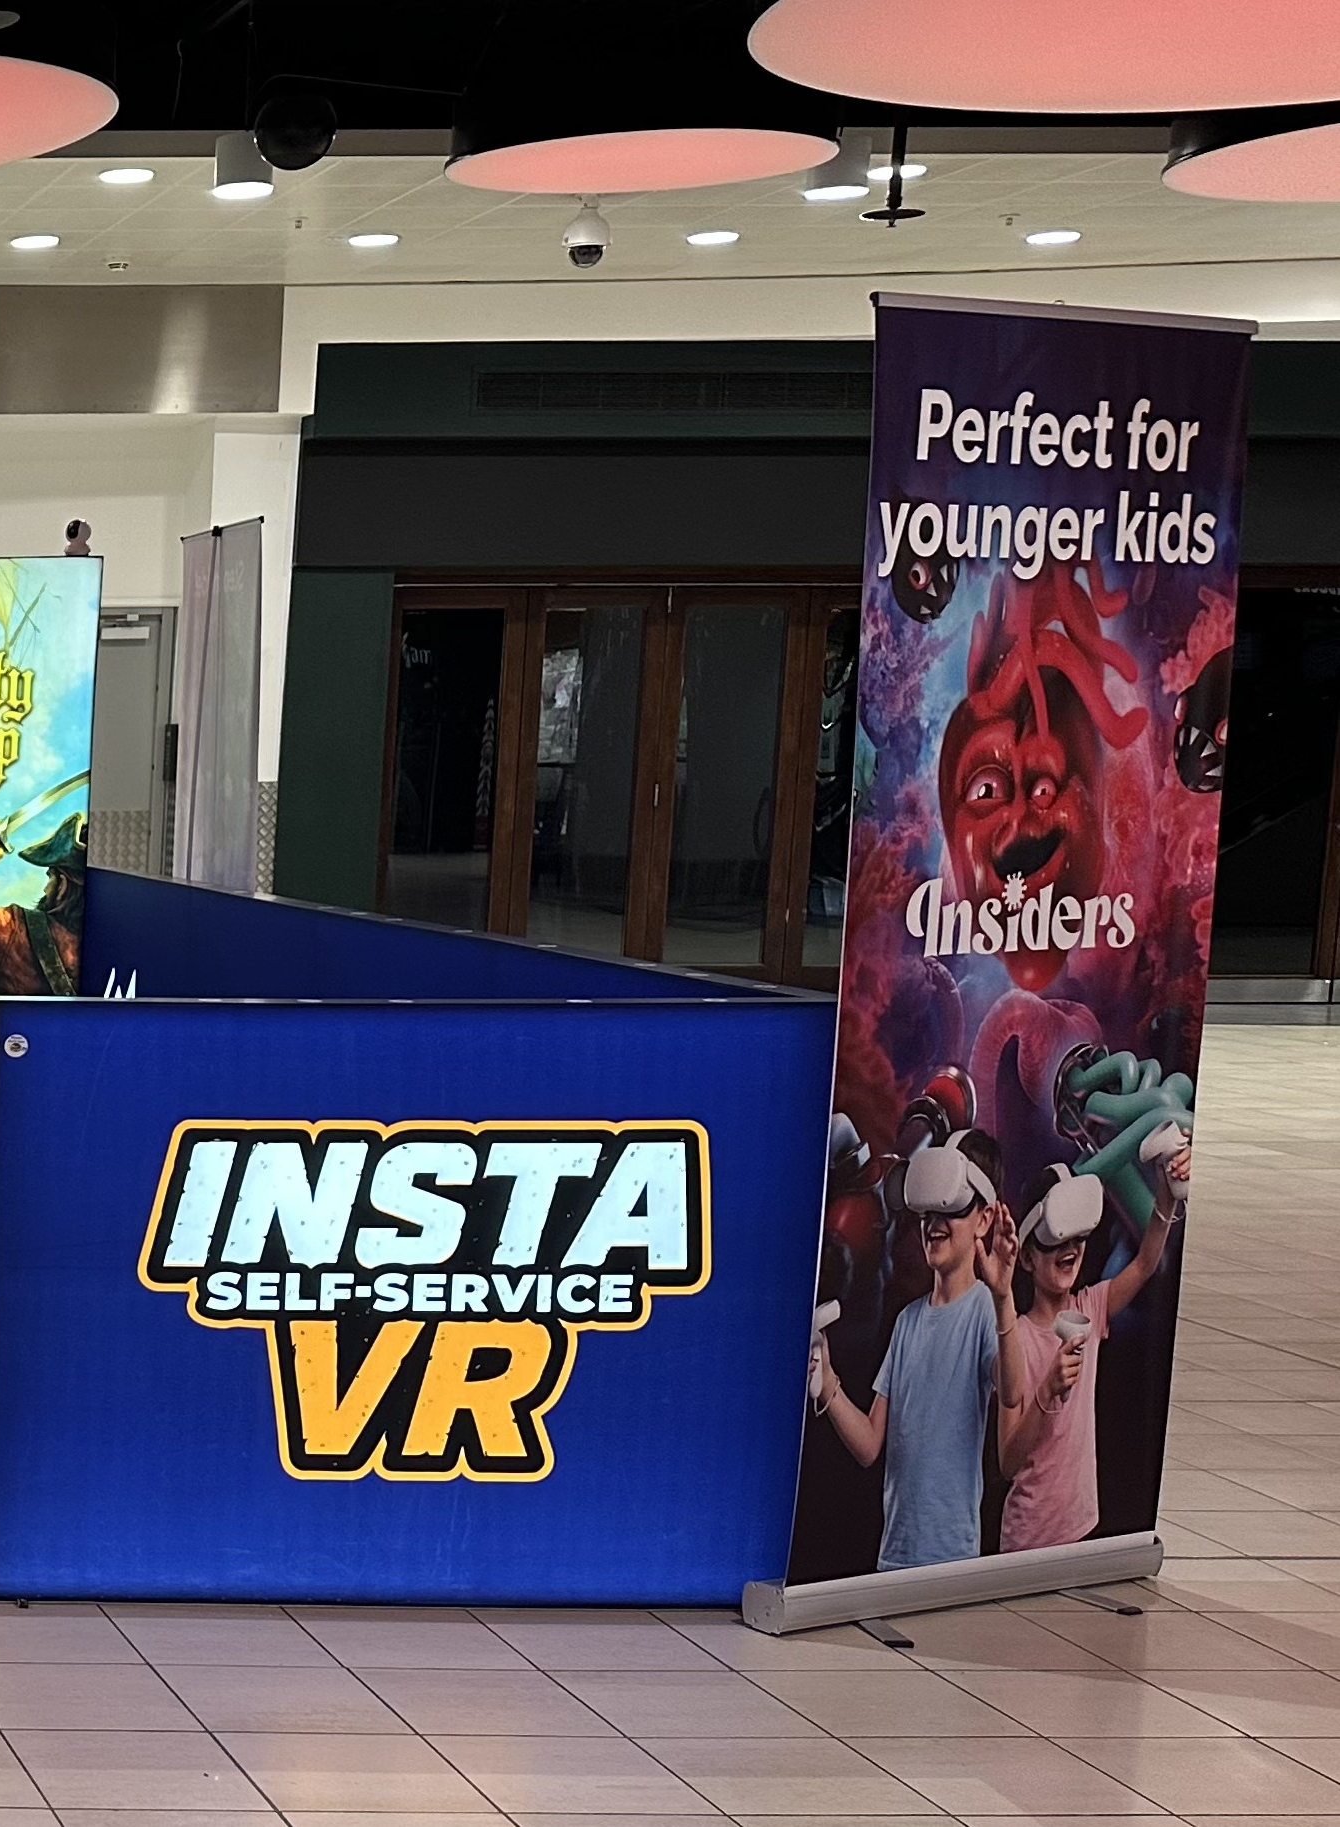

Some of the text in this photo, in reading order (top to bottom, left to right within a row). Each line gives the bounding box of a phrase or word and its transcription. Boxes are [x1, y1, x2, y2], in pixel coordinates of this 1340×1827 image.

[916, 387, 1200, 473] Perfect for
[877, 489, 1218, 580] younger kids
[904, 871, 1136, 959] Insiders
[162, 1140, 689, 1271] INSTA
[204, 1273, 634, 1313] SELF-SERVICE
[288, 1320, 552, 1459] VR
